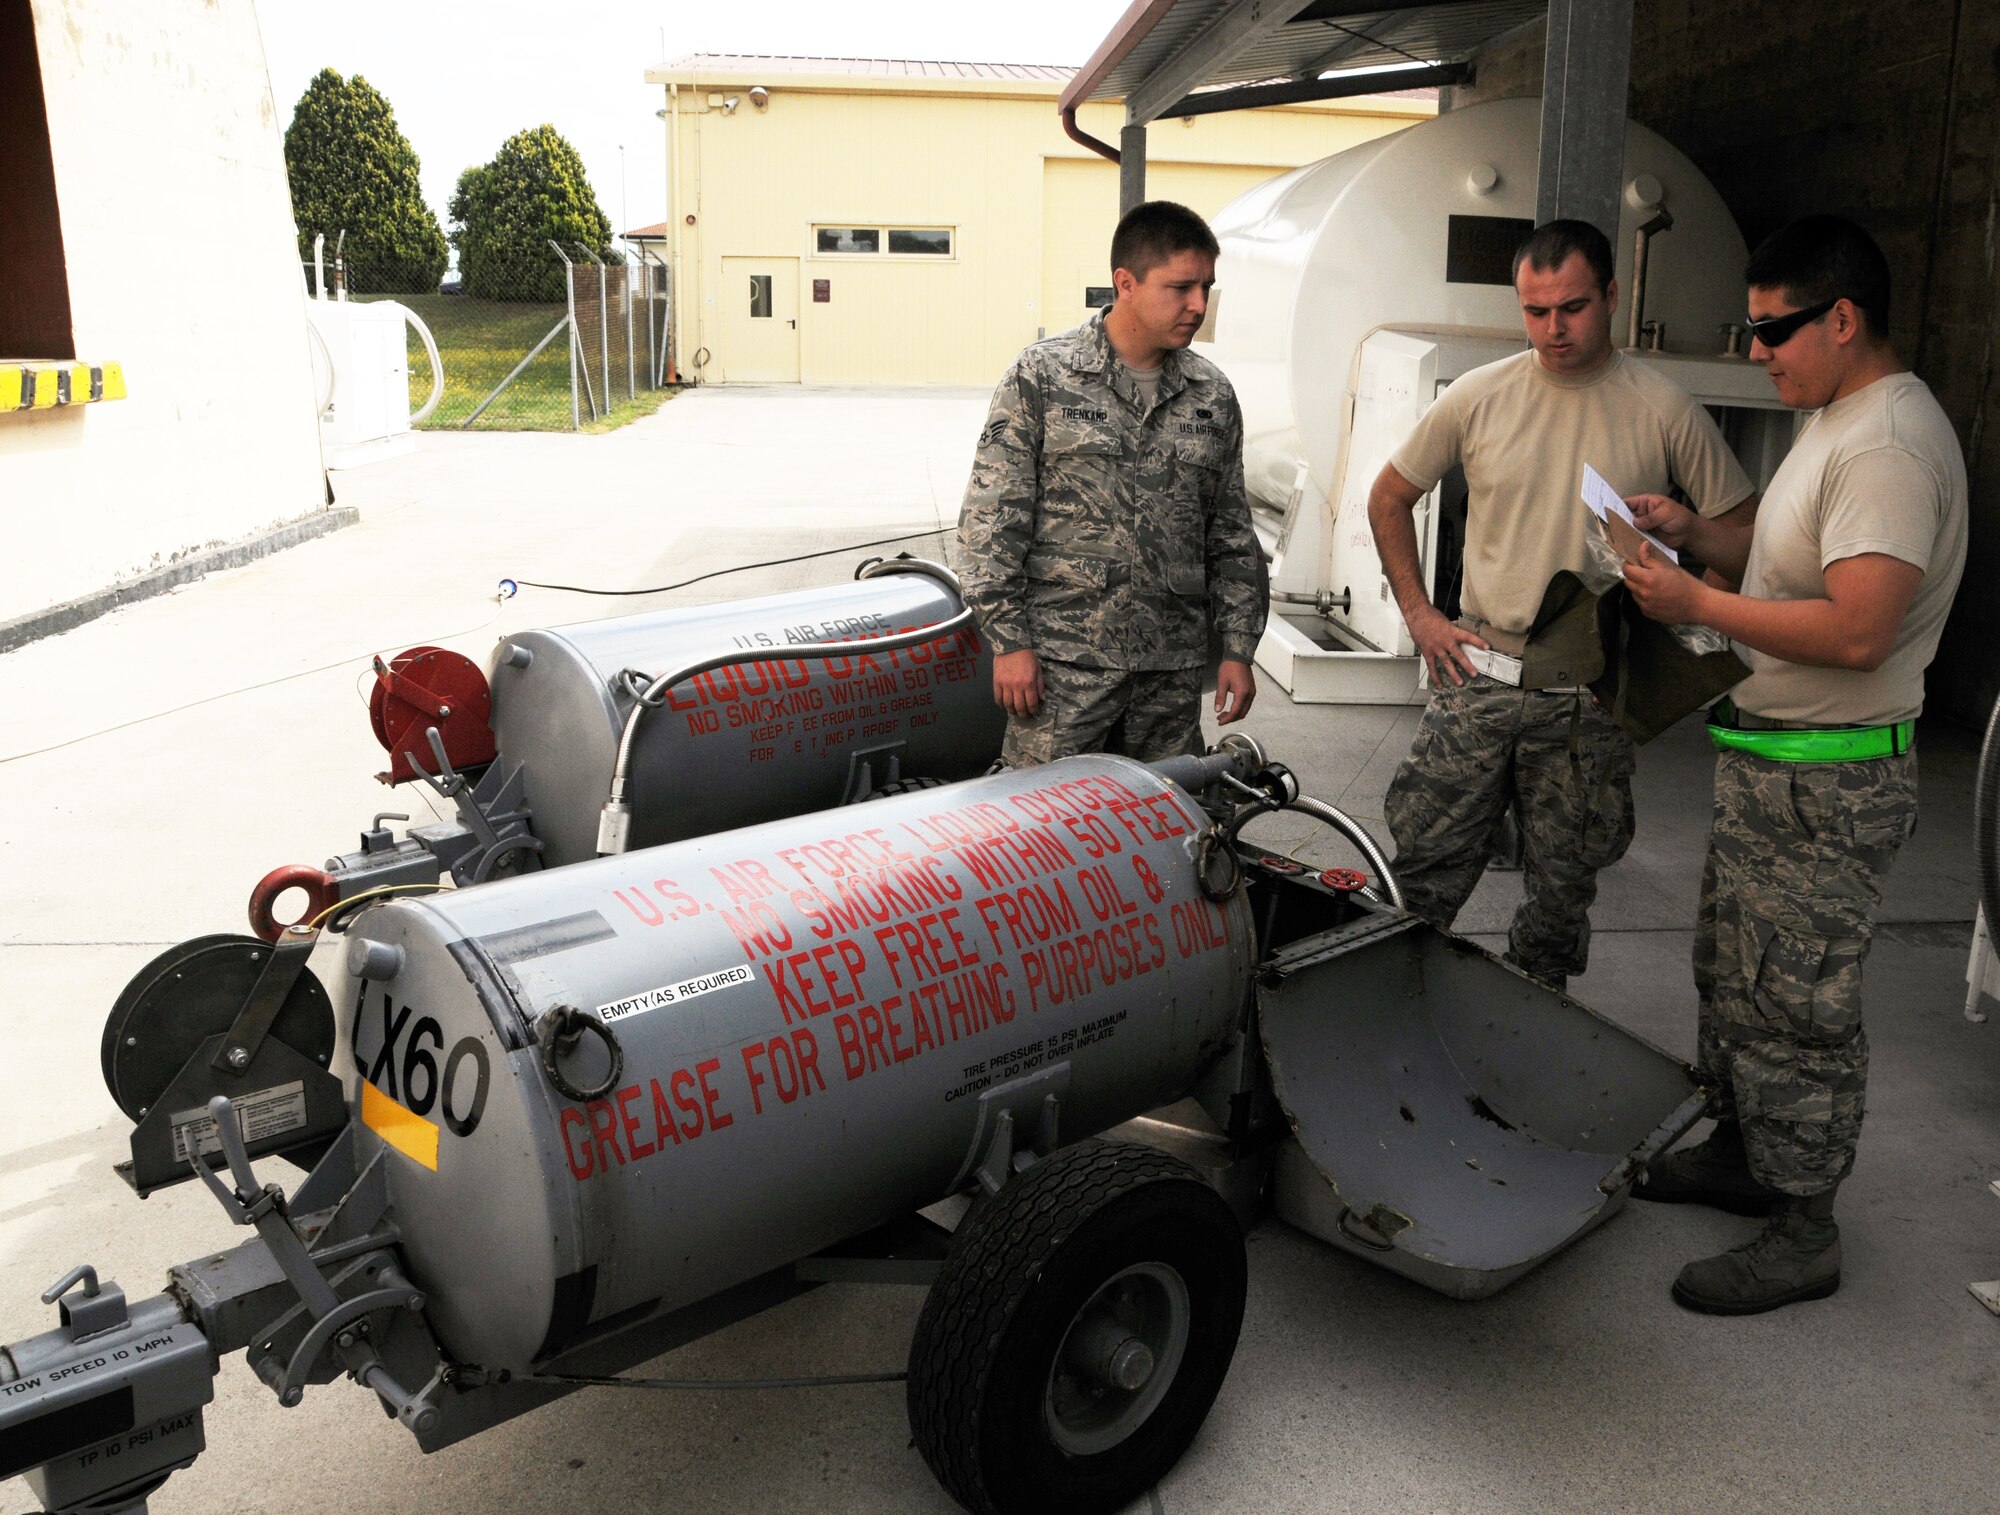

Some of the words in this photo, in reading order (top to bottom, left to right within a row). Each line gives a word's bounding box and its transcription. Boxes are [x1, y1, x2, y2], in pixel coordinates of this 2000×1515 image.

[1061, 408, 1107, 422] TRENKAMP
[1179, 423, 1194, 434] U.S.
[1195, 424, 1207, 436] AIR
[784, 625, 819, 645] AIR
[820, 613, 892, 638] FORCE
[687, 709, 720, 737] NO
[726, 688, 824, 728] SMOKING
[828, 672, 898, 705] WITHIN
[902, 667, 928, 690] 50
[933, 658, 977, 684] FEET
[751, 723, 782, 743] KEEP
[787, 715, 817, 735] FEE
[822, 707, 855, 727] FROM
[859, 704, 876, 719] OIL
[879, 702, 887, 714] &
[891, 692, 933, 712] GREASE
[750, 746, 774, 762] FOR
[911, 711, 938, 728] ONLY
[612, 879, 715, 926] U.S.
[709, 859, 788, 904] AIR
[775, 828, 914, 884] FORCE
[898, 803, 1021, 852] LIQUID
[1009, 775, 1138, 823] OXYGEN
[719, 900, 793, 961] NO
[790, 855, 963, 940] SMOKING
[951, 825, 1077, 891] WITHIN
[1061, 813, 1122, 859] 50
[1110, 790, 1196, 846] FEET
[763, 938, 866, 1026] KEEP
[873, 907, 980, 988] FREE
[975, 878, 1081, 955] FROM
[1077, 864, 1137, 921] OIL
[1132, 854, 1165, 902] &
[560, 1057, 733, 1182] GREASE
[741, 1027, 826, 1115] FOR
[833, 962, 1016, 1081] BREATHING
[1021, 913, 1165, 1013] PURPOSES
[1170, 895, 1232, 958] ONLY
[945, 1075, 991, 1102] CAUTION
[1004, 1064, 1020, 1079] DO
[1023, 1054, 1044, 1070] NOT
[1048, 1042, 1074, 1060] OVER
[1077, 1026, 1114, 1050] INFLATE
[963, 1061, 986, 1079] TIRE
[990, 1041, 1044, 1069] PRESSURE
[1048, 1035, 1058, 1048] 15
[1062, 1028, 1077, 1042] PSI
[1082, 1010, 1127, 1036] MAXIMUM
[1, 1377, 41, 1396] TOW
[49, 1358, 106, 1382] SPEED
[135, 1336, 173, 1354] MPH
[78, 1451, 98, 1468] TP
[129, 1430, 153, 1450] PSI
[161, 1414, 194, 1437] MAX
